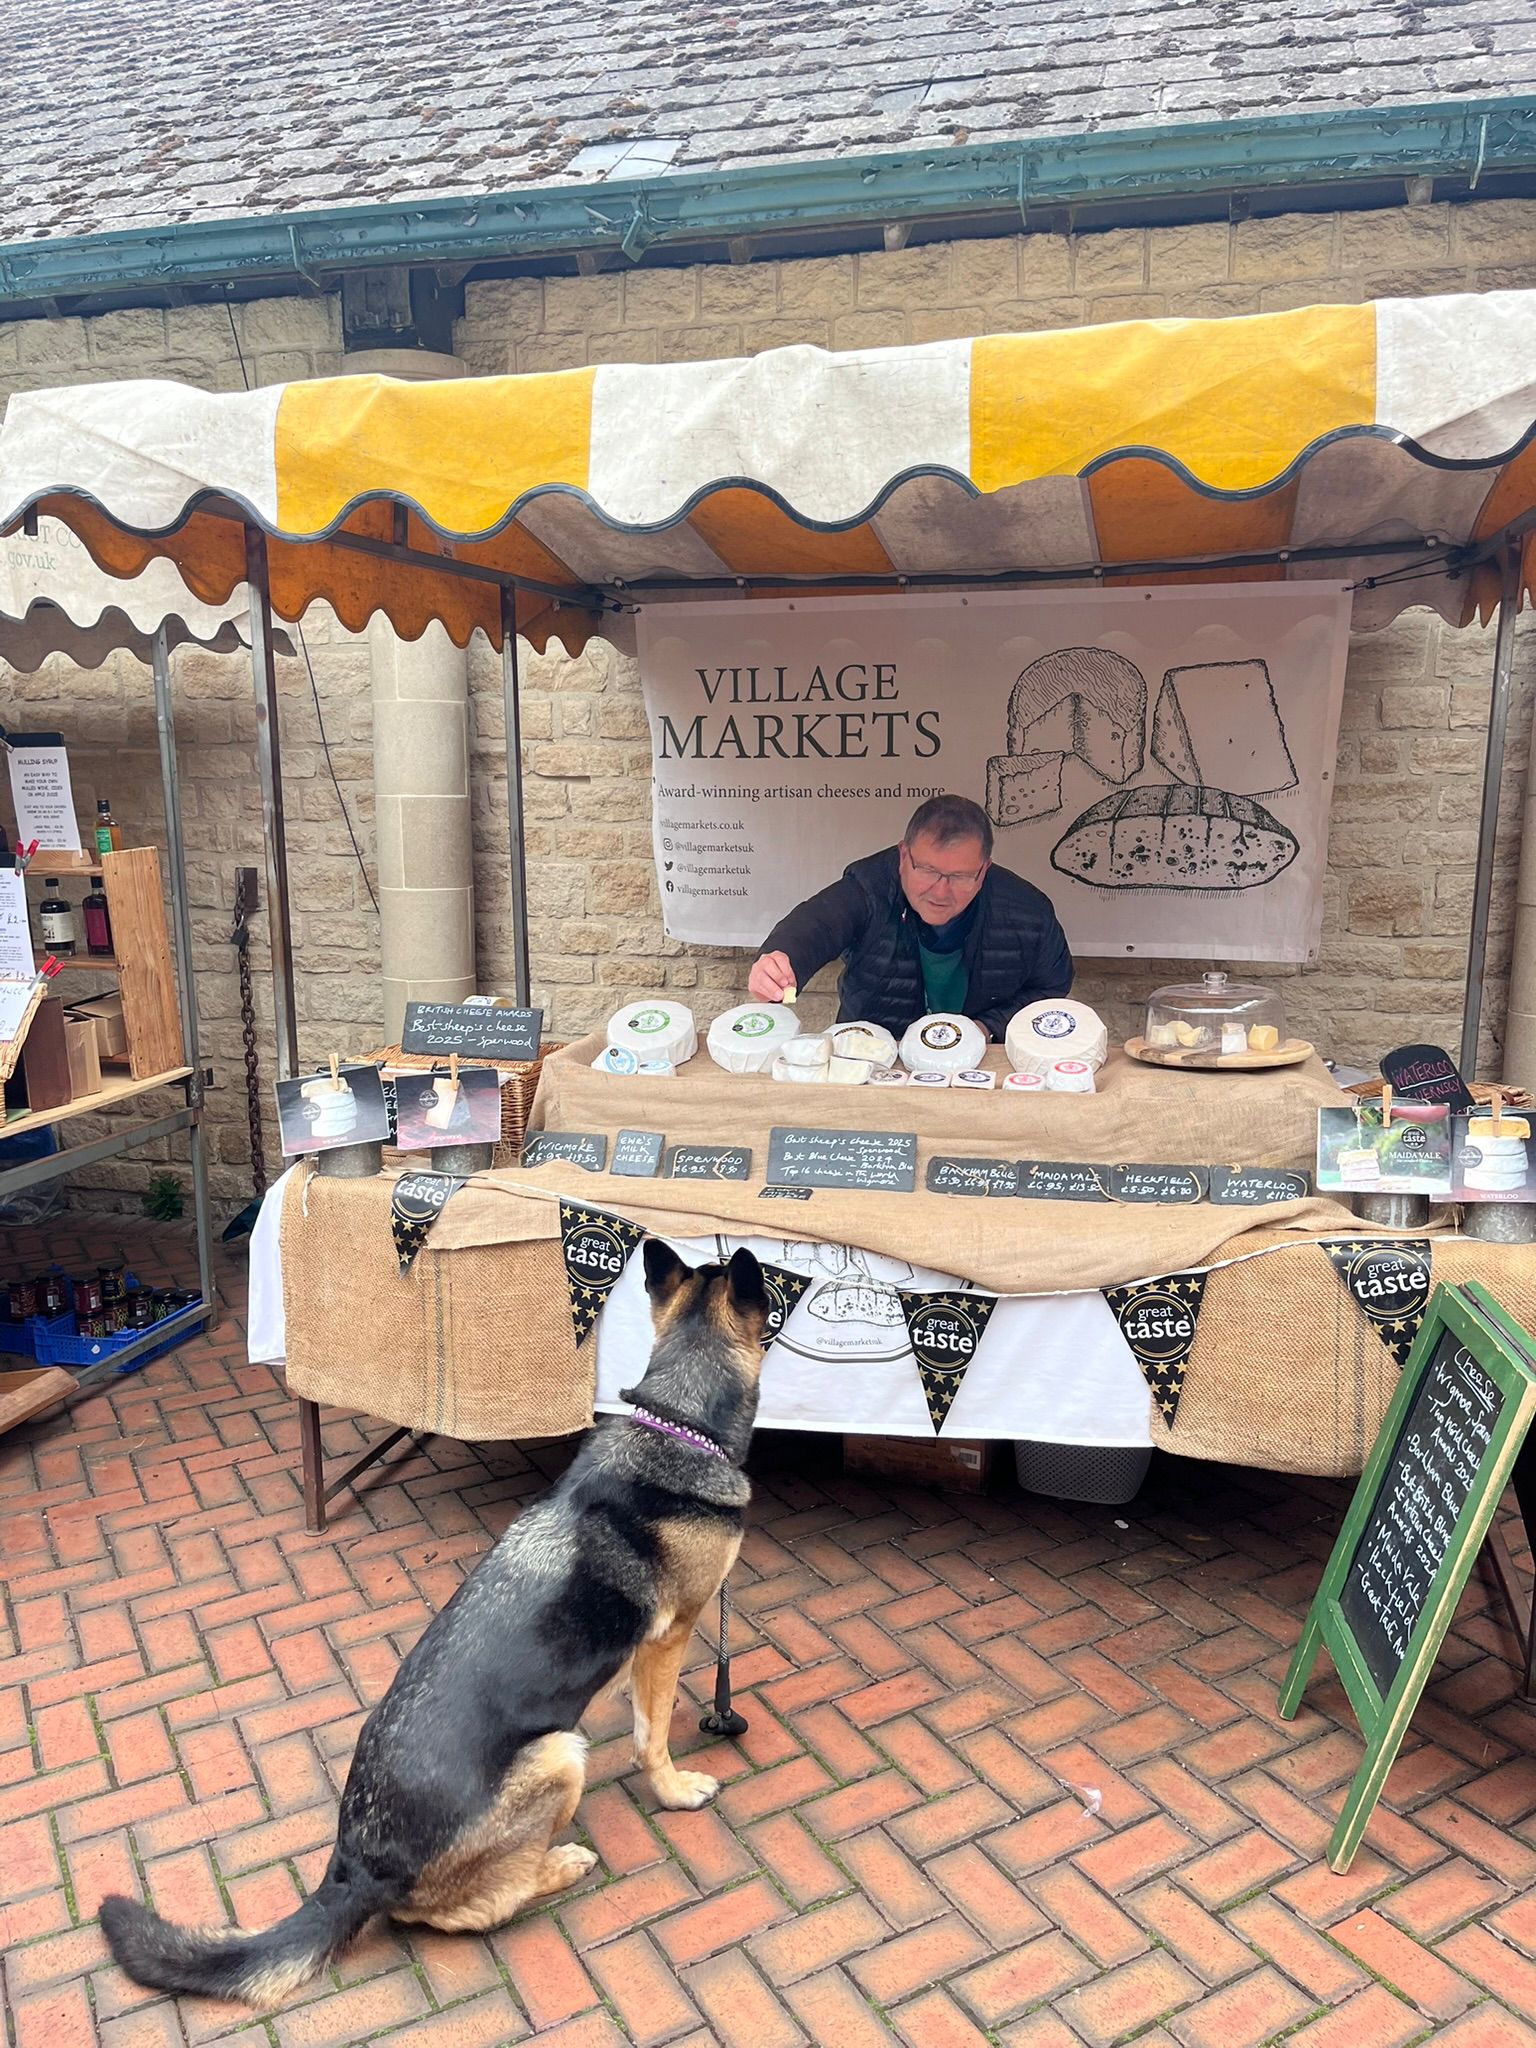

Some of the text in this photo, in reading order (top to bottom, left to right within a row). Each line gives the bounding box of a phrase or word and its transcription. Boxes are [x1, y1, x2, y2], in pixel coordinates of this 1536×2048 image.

[695, 664, 899, 704] VILLAGE
[658, 710, 942, 759] MARKETS
[658, 784, 760, 803] Award-winning
[764, 785, 813, 799] artisan
[817, 784, 871, 799] cheeses
[874, 783, 902, 798] and
[660, 818, 745, 832] villagemarkets.co.uk
[675, 842, 755, 855] @villagemarketsuk
[677, 884, 749, 898] villagemarketsuk
[417, 1005, 533, 1018] BRITISH CHEESE AWARDS
[410, 1018, 442, 1033] Best
[486, 1020, 528, 1032] cheese
[426, 1035, 463, 1044] 2025
[1391, 1059, 1455, 1090] WATERLOO
[888, 1138, 912, 1148] 2025
[1403, 1135, 1426, 1143] taste
[538, 1142, 595, 1152] WIGMORE
[620, 1144, 649, 1155] MILK
[615, 1153, 656, 1164] CHEESE
[676, 1155, 743, 1165] SPENWOOD
[1389, 1151, 1442, 1160] MAIDA VALE
[414, 1174, 441, 1187] great
[1033, 1171, 1069, 1181] MAIDA
[1125, 1174, 1193, 1185] HECKFIELD
[1227, 1178, 1297, 1191] WATERLOO
[396, 1179, 446, 1207] taste
[580, 1235, 611, 1252] great
[566, 1243, 622, 1274] taste
[1367, 1257, 1406, 1279] great
[1353, 1270, 1427, 1299] taste
[1137, 1306, 1173, 1320] great
[926, 1317, 960, 1333] great
[1123, 1317, 1191, 1340] taste
[912, 1327, 974, 1354] taste
